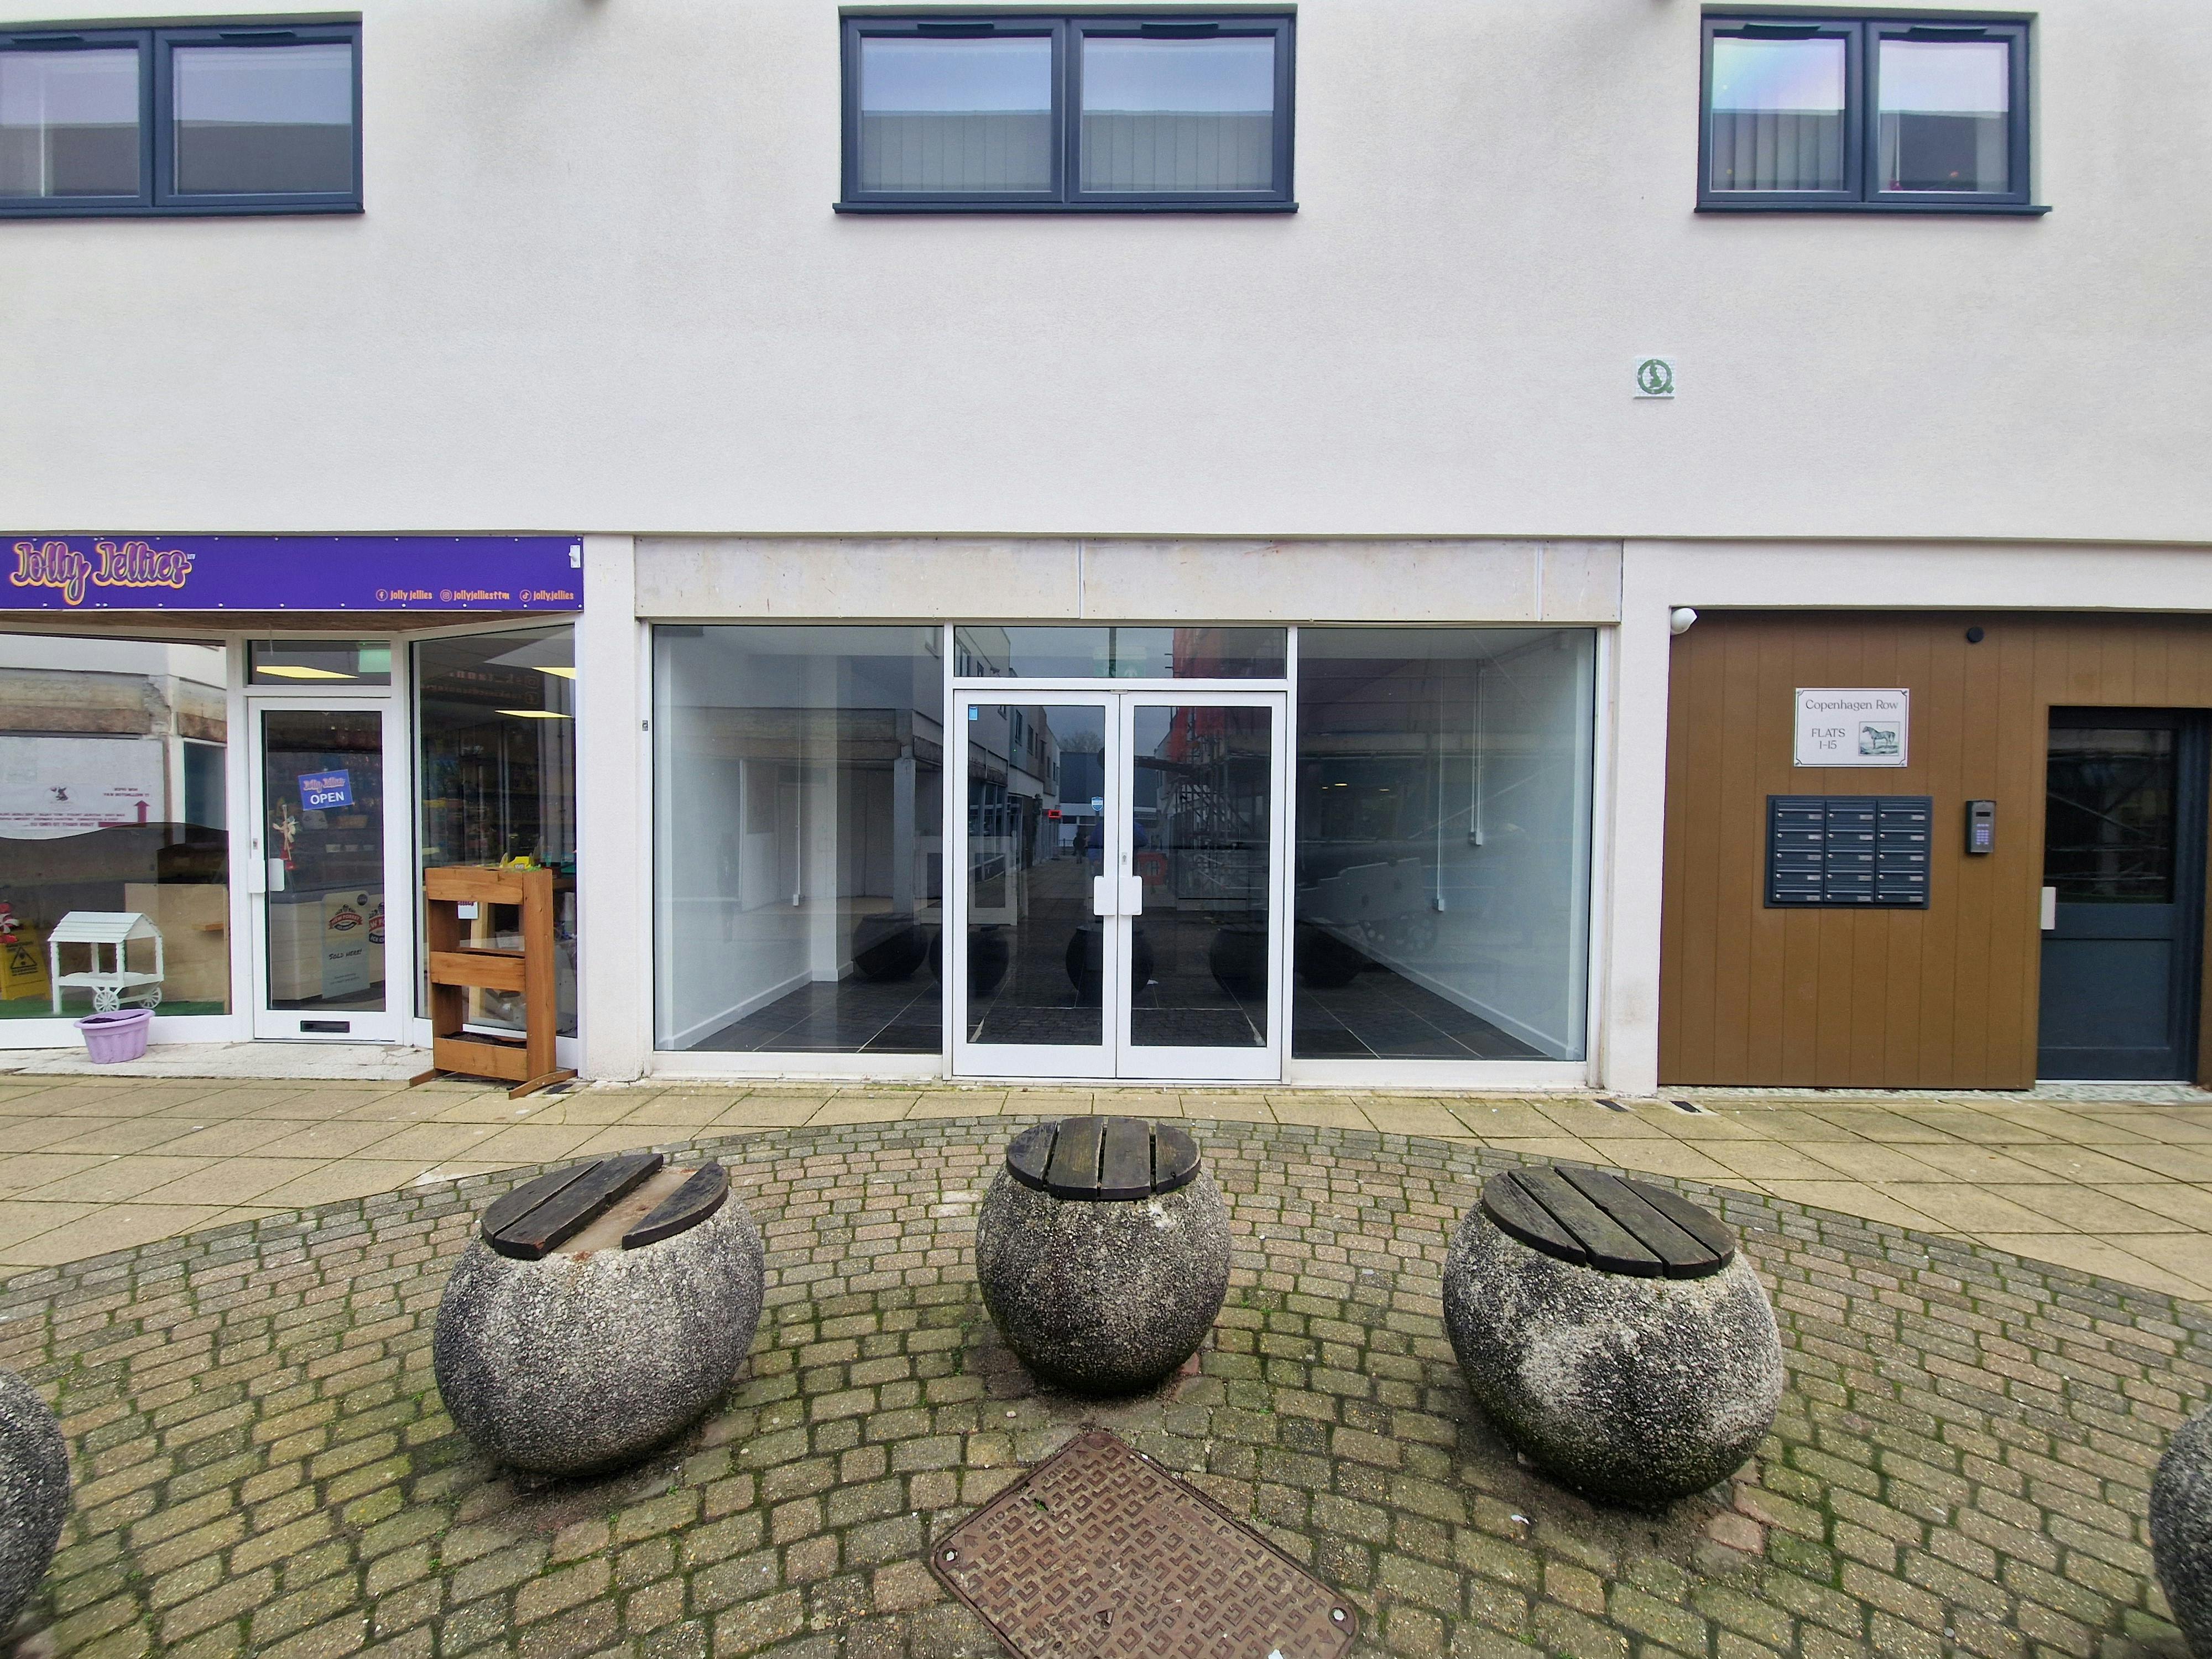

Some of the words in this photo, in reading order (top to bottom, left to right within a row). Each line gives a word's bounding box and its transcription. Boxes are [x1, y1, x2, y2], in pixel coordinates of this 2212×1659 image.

[10, 541, 91, 606] Jolly
[92, 541, 192, 588] Jellies
[390, 590, 408, 601] jolly
[409, 590, 432, 601] jellies
[453, 590, 509, 601] jollyjelliesttm
[533, 589, 574, 601] jolly.jellies
[1806, 699, 1872, 712] Copenhagen
[1876, 700, 1898, 709] Row
[1812, 728, 1845, 738] FLATS
[1819, 740, 1837, 749] 1-15
[310, 791, 345, 805] OPEN
[979, 1510, 1005, 1532] OUT
[1034, 1621, 1076, 1659] HOUSE
